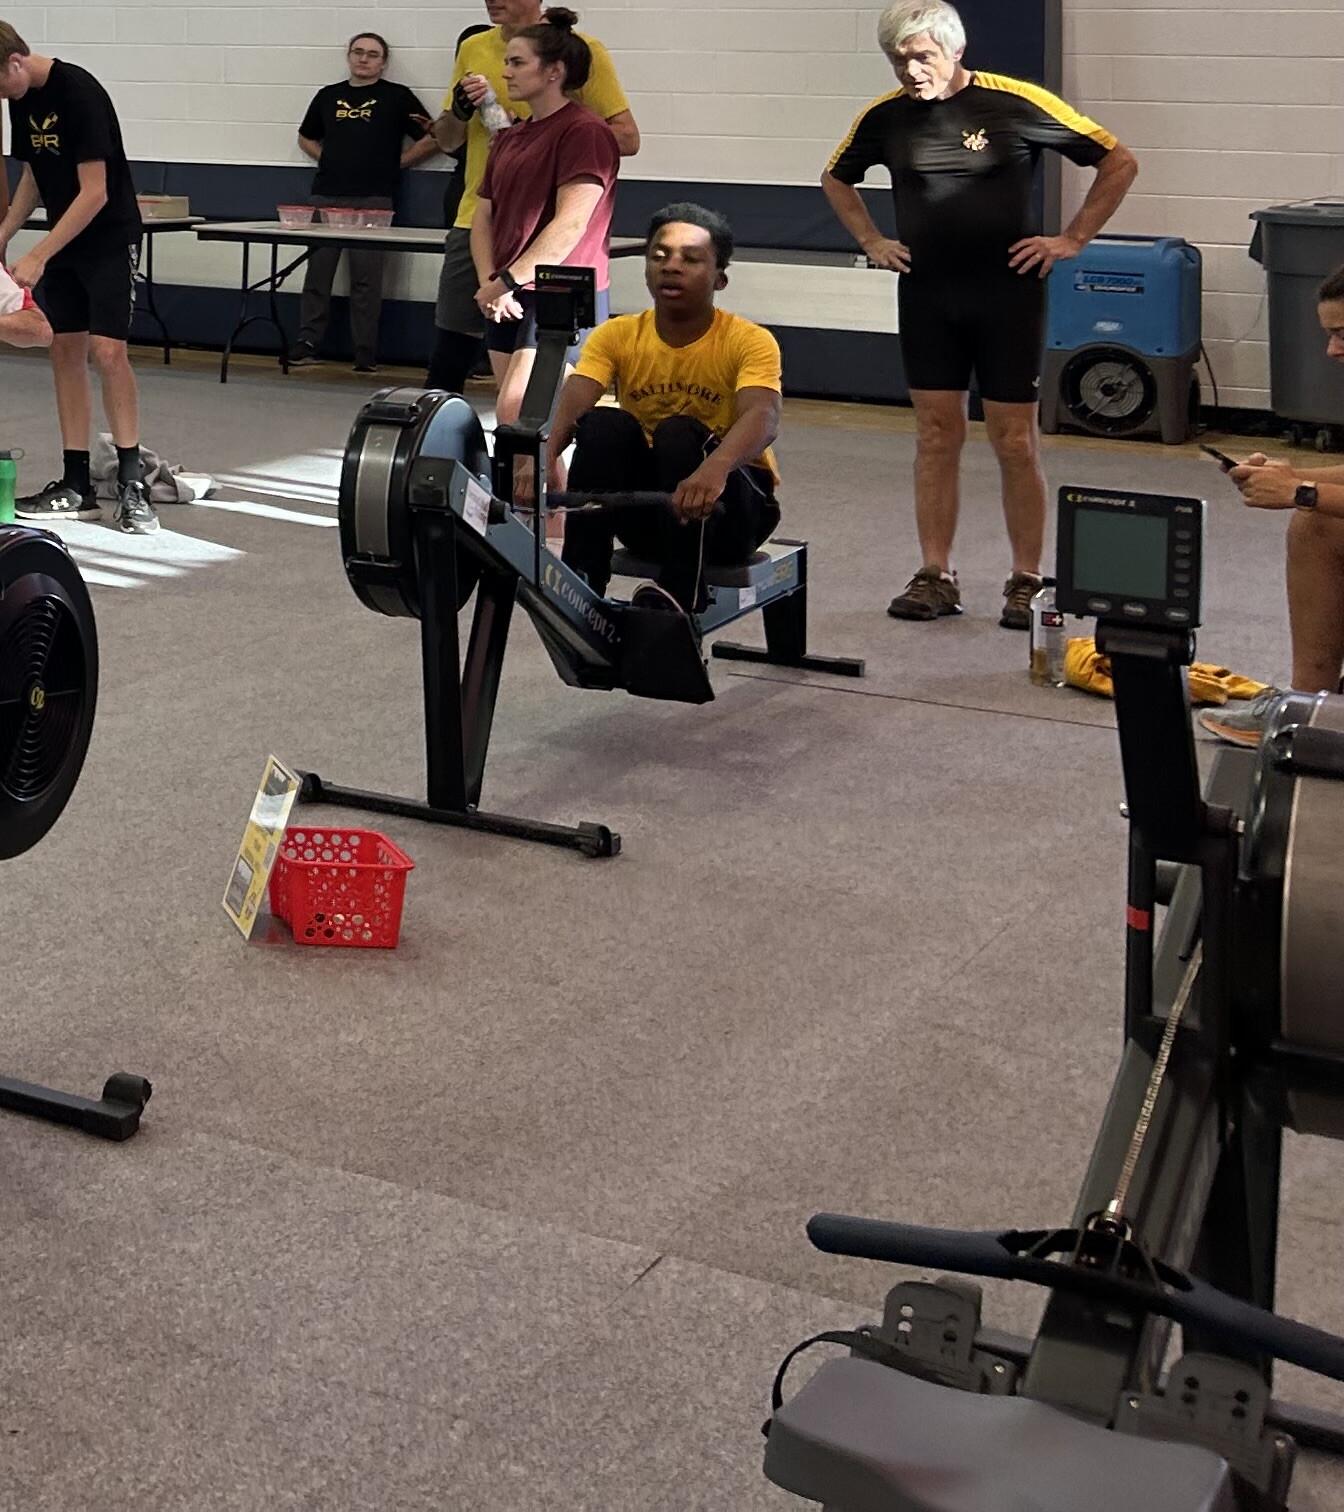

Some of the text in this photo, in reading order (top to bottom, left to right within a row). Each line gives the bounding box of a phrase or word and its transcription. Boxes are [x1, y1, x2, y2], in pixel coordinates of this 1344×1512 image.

[335, 108, 372, 119] BCR
[560, 582, 616, 644] concept 2
